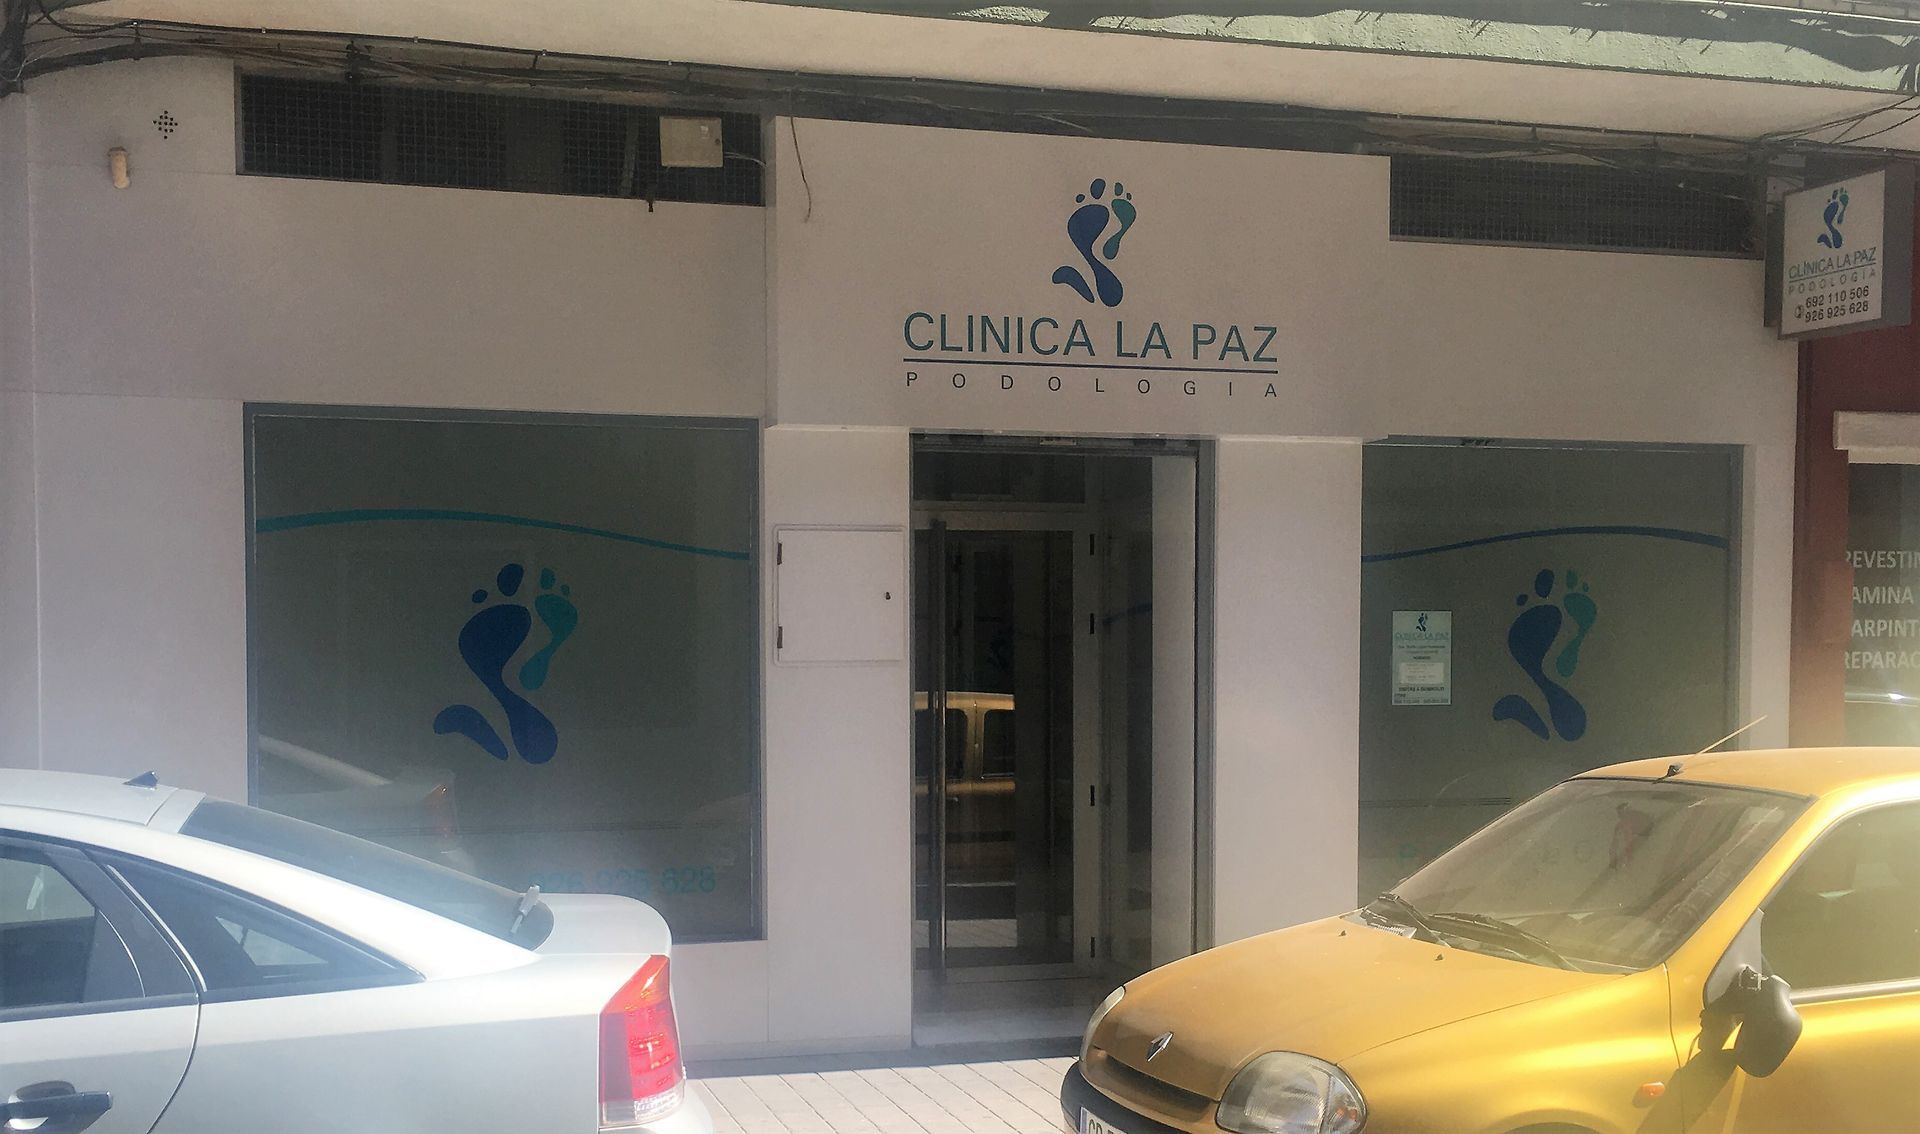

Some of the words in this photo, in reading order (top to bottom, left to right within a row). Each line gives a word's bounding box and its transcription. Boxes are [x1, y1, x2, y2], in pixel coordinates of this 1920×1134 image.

[1788, 257, 1835, 279] CLINICA
[1836, 253, 1852, 268] LA
[1854, 247, 1877, 264] PAZ
[1788, 267, 1877, 295] PODOLOGIA
[1805, 294, 1825, 309] 692
[1828, 290, 1847, 304] 110
[1849, 285, 1869, 300] 506
[1805, 308, 1825, 323] 926
[1827, 304, 1847, 319] 925
[1849, 300, 1869, 314] 628
[903, 311, 1096, 357] CLINICA
[1115, 320, 1173, 359] LA
[1191, 323, 1279, 364] PAZ
[905, 370, 1279, 399] PODOLOGIA
[1851, 585, 1914, 605] AMINA
[1851, 618, 1920, 638] ARPINT
[661, 865, 716, 893] 628
